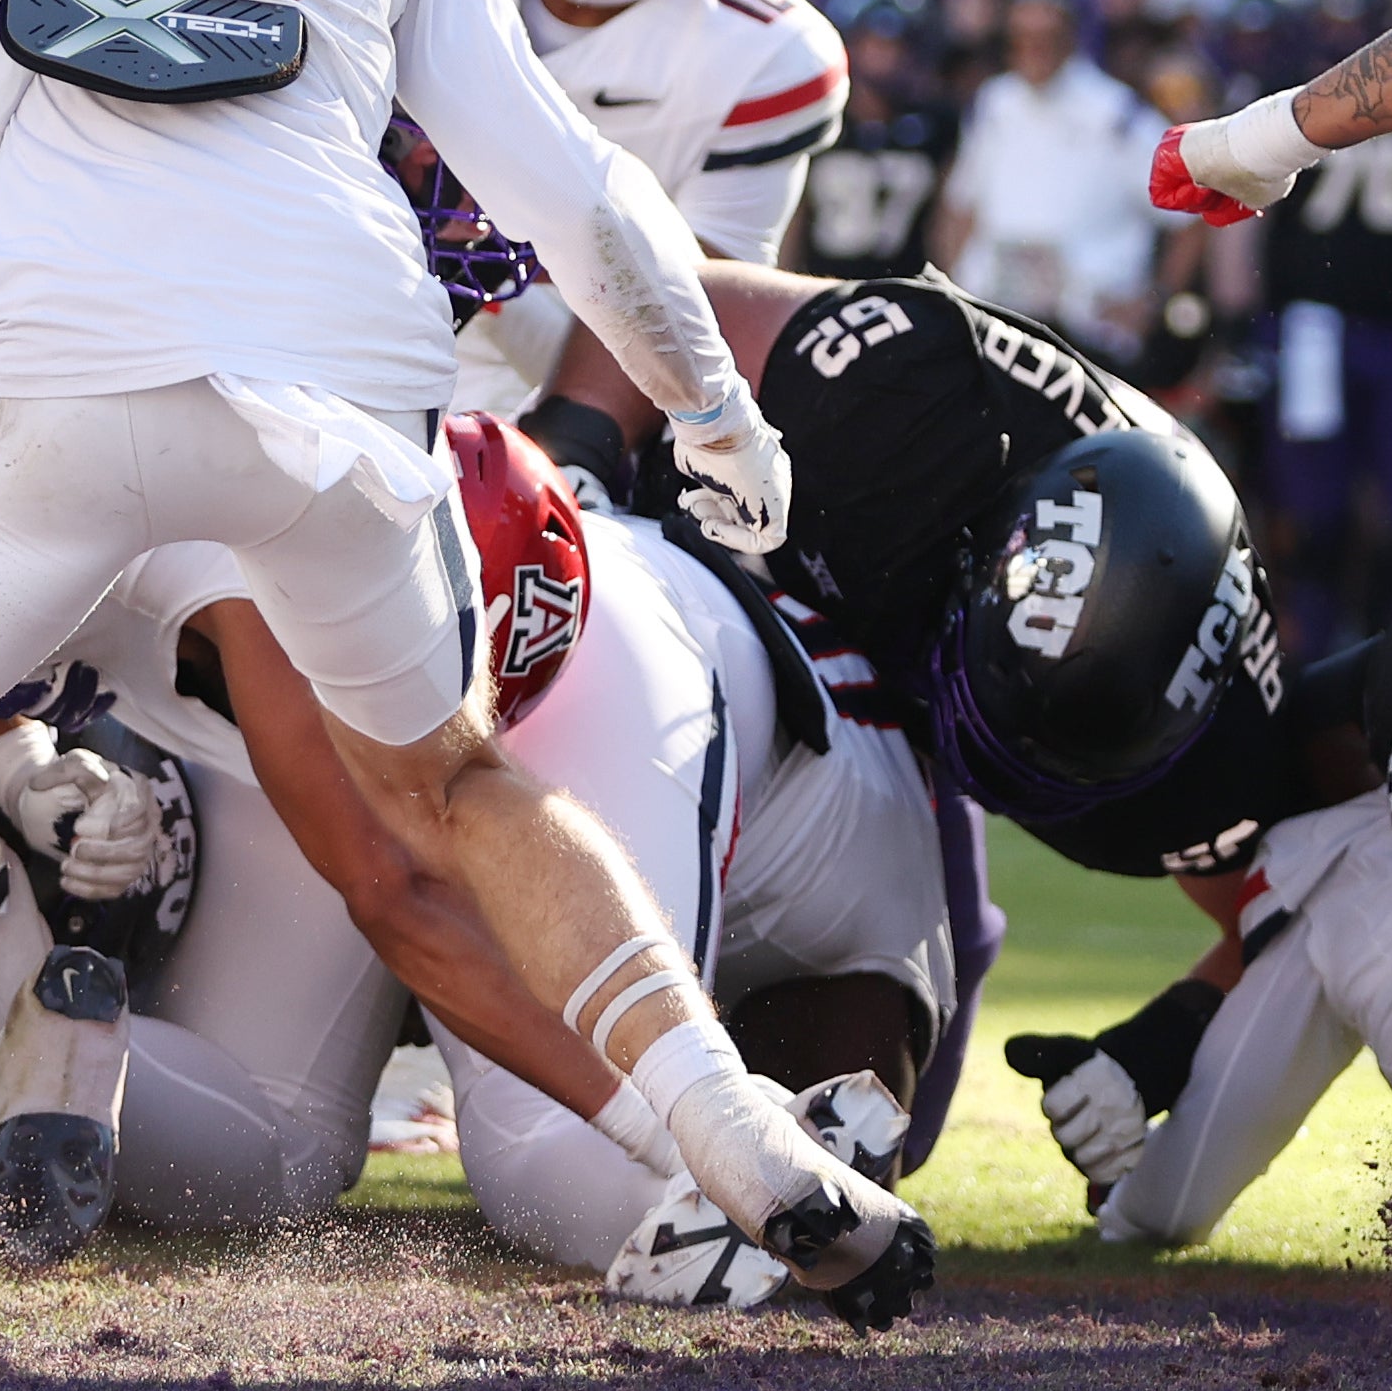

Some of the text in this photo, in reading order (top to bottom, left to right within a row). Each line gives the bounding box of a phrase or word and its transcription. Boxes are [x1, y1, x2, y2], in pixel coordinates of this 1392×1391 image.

[501, 564, 583, 677] A
[1007, 490, 1103, 661] TCU
[1164, 544, 1254, 716] TCU
